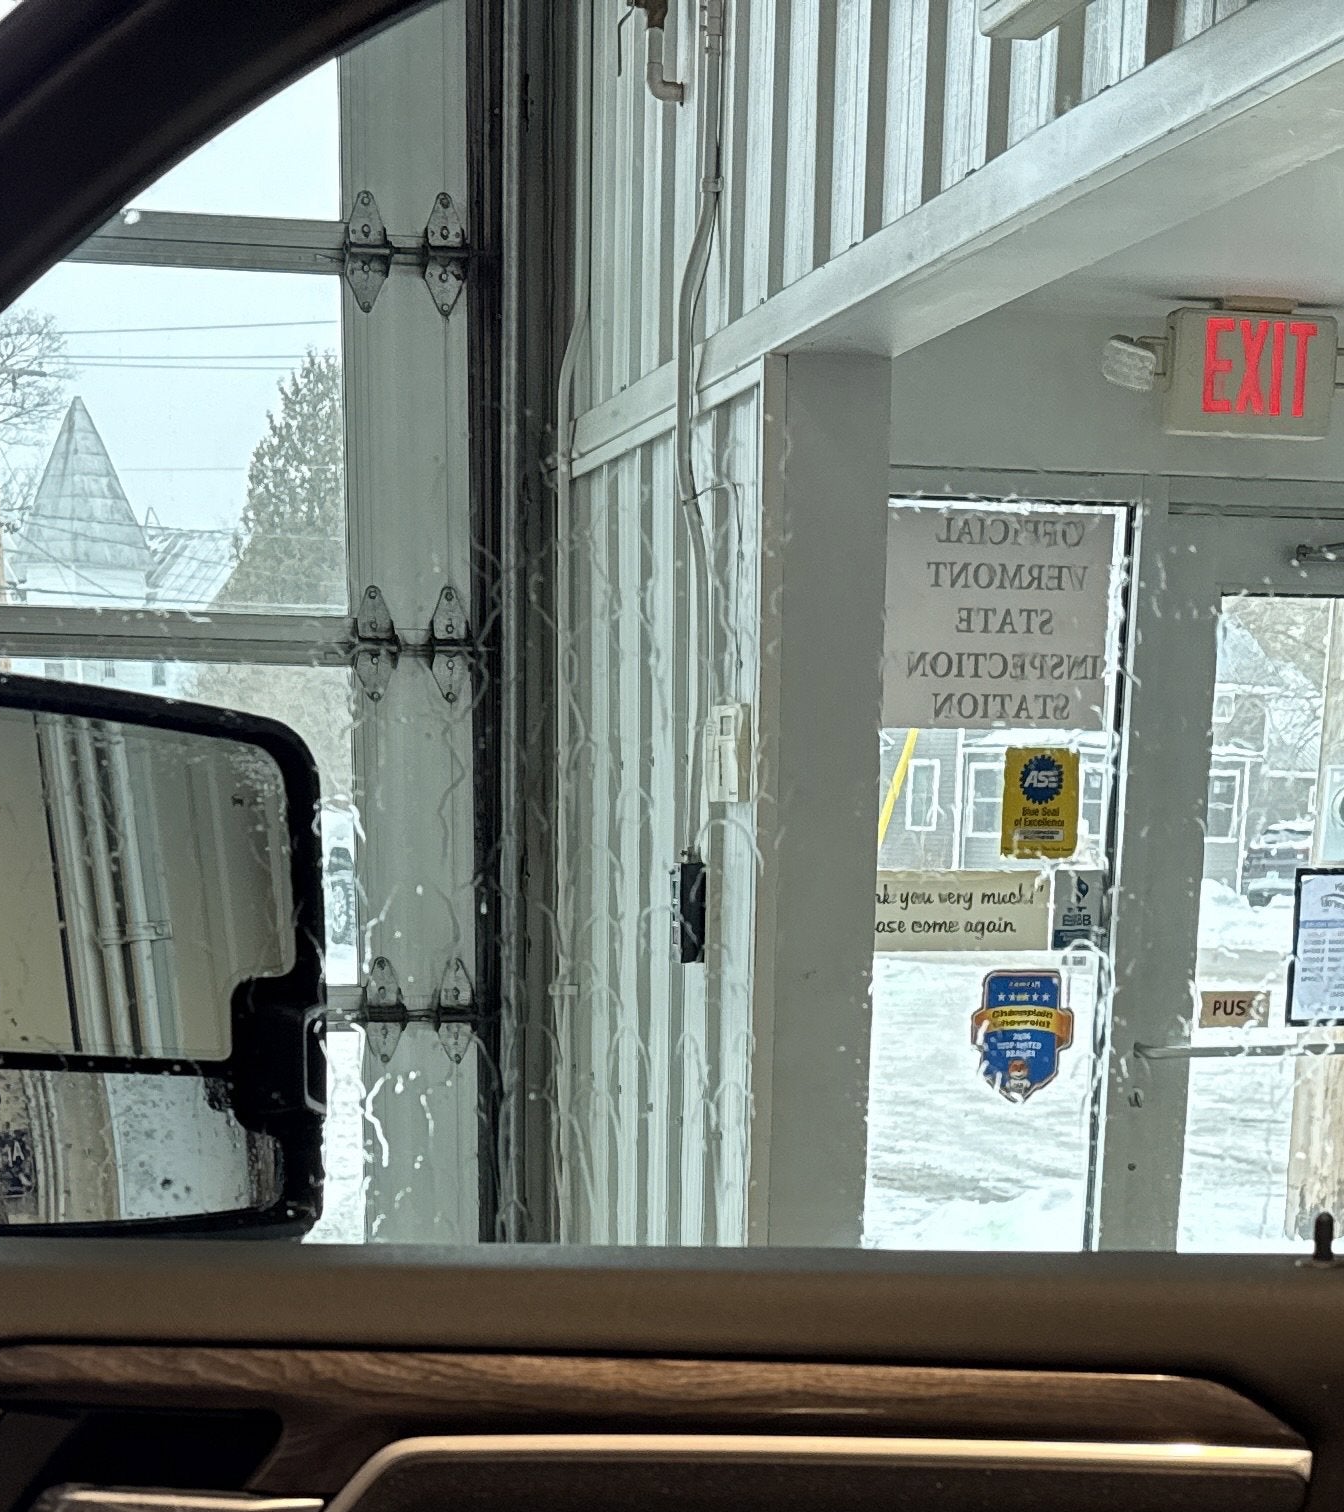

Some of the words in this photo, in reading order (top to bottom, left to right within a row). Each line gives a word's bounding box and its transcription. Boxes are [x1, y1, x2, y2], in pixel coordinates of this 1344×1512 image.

[1202, 315, 1319, 418] EXIT
[1023, 770, 1059, 788] ASE
[900, 891, 934, 911] you
[911, 920, 959, 933] come
[964, 917, 1017, 941] again
[1212, 999, 1258, 1017] PUS
